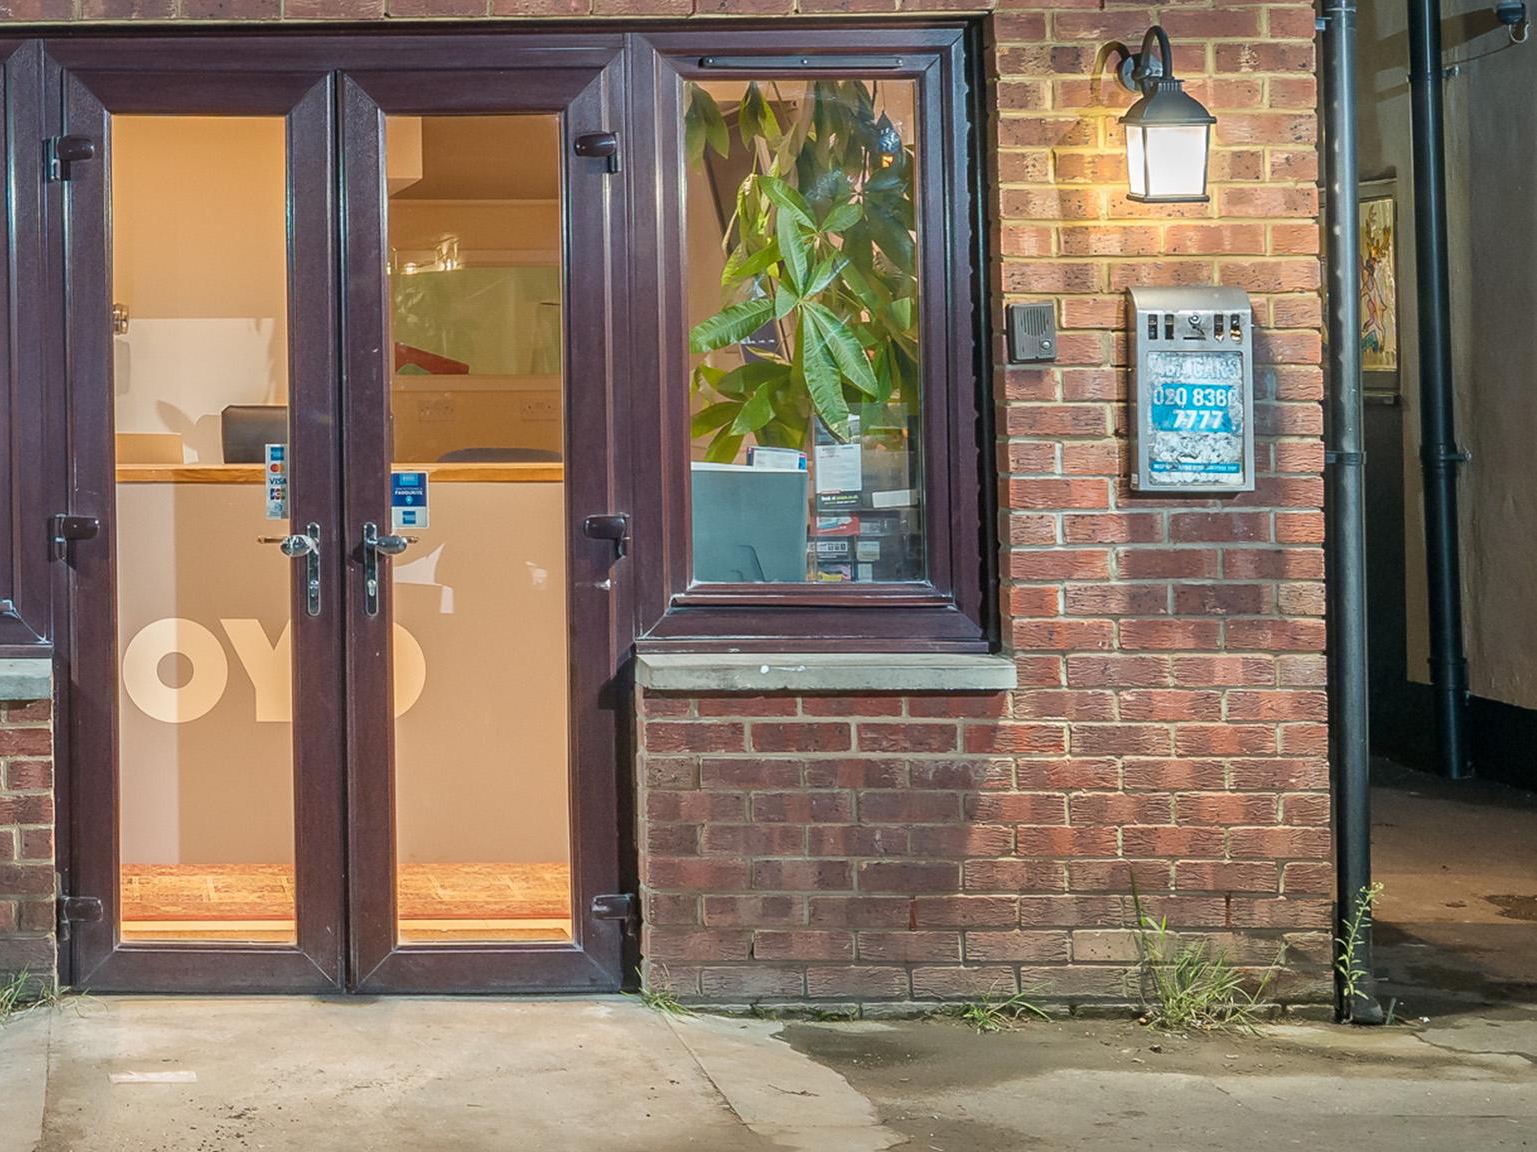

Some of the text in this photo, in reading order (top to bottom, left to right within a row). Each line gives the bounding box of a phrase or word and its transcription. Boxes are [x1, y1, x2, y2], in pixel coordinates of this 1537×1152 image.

[1153, 387, 1188, 408] 020
[1172, 409, 1224, 429] 7777
[122, 618, 426, 723] OY
